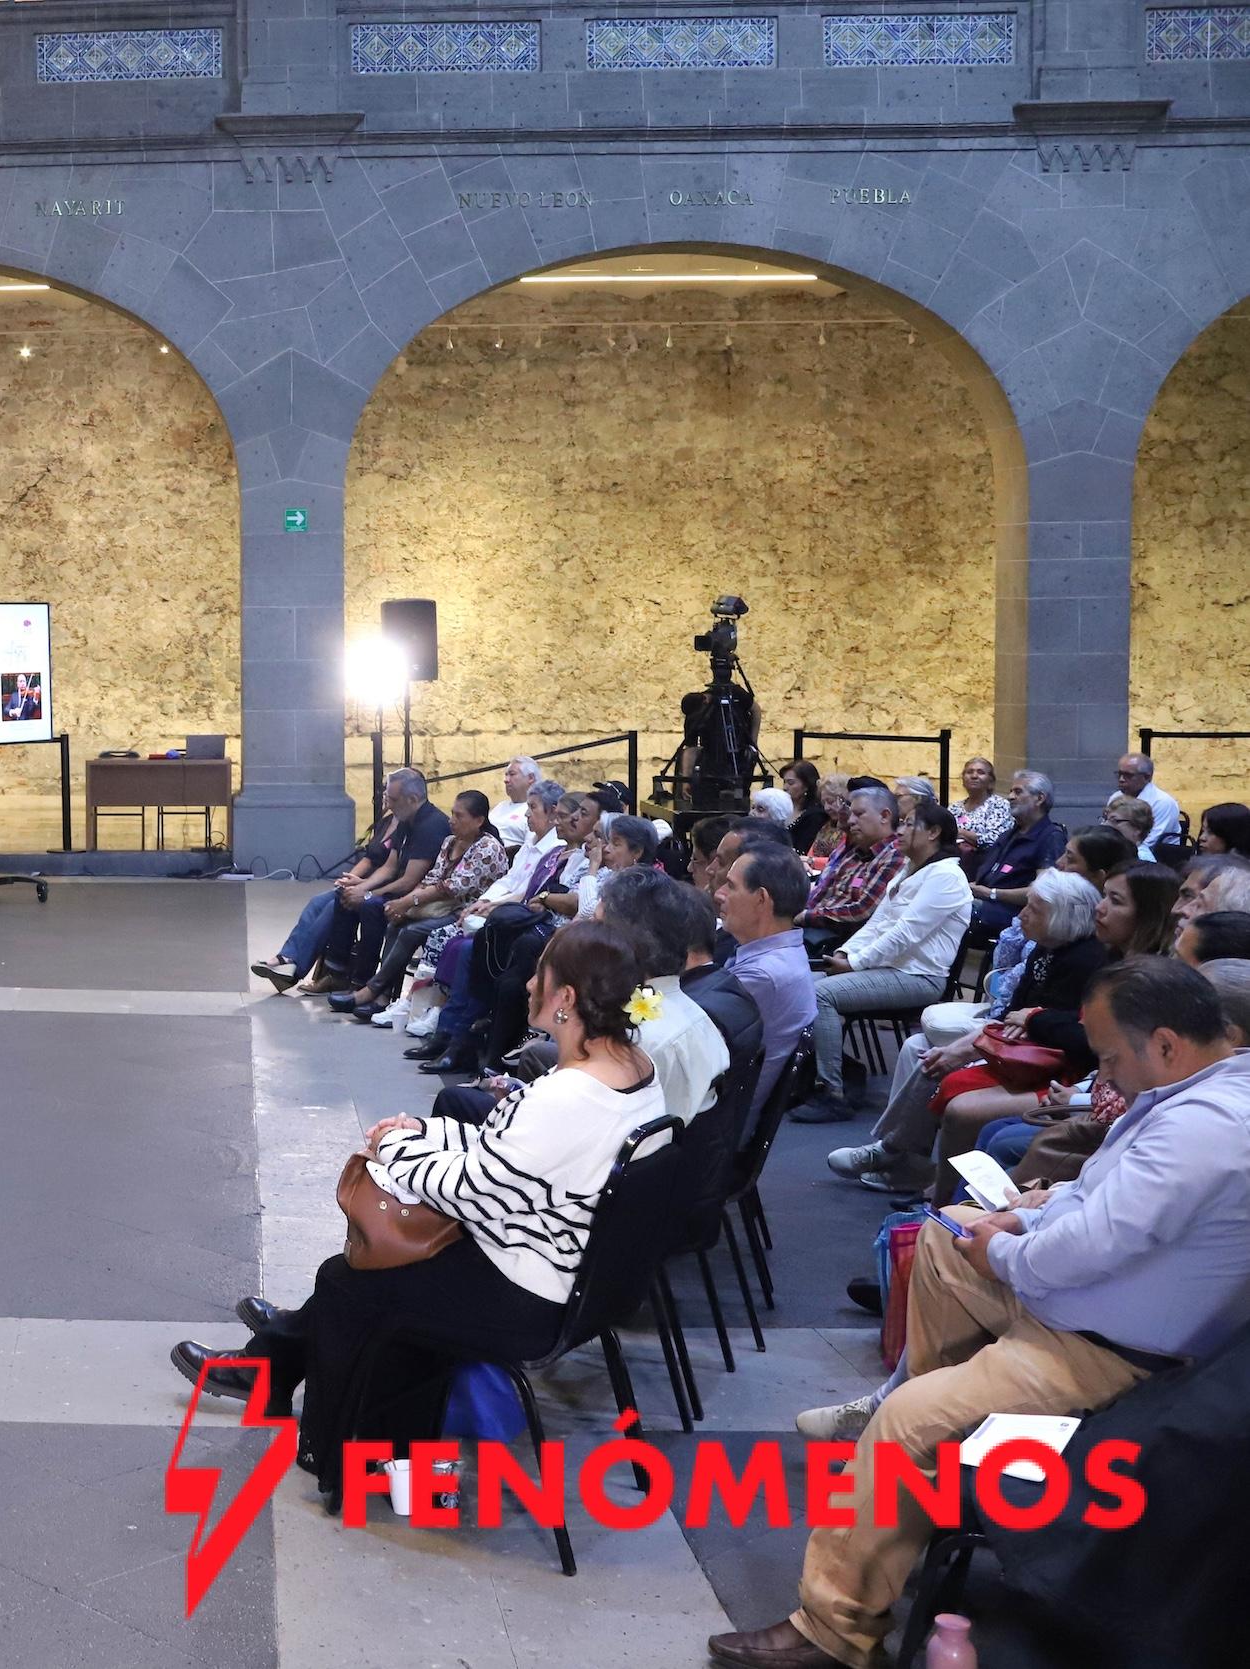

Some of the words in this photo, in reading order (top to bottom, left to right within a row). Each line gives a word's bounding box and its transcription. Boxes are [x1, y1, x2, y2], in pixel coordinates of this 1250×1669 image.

[458, 191, 531, 208] NUEVO
[538, 191, 592, 207] LEON
[669, 190, 754, 206] OAXACA
[830, 188, 912, 204] PUEBLA
[35, 200, 125, 217] NAYARIT
